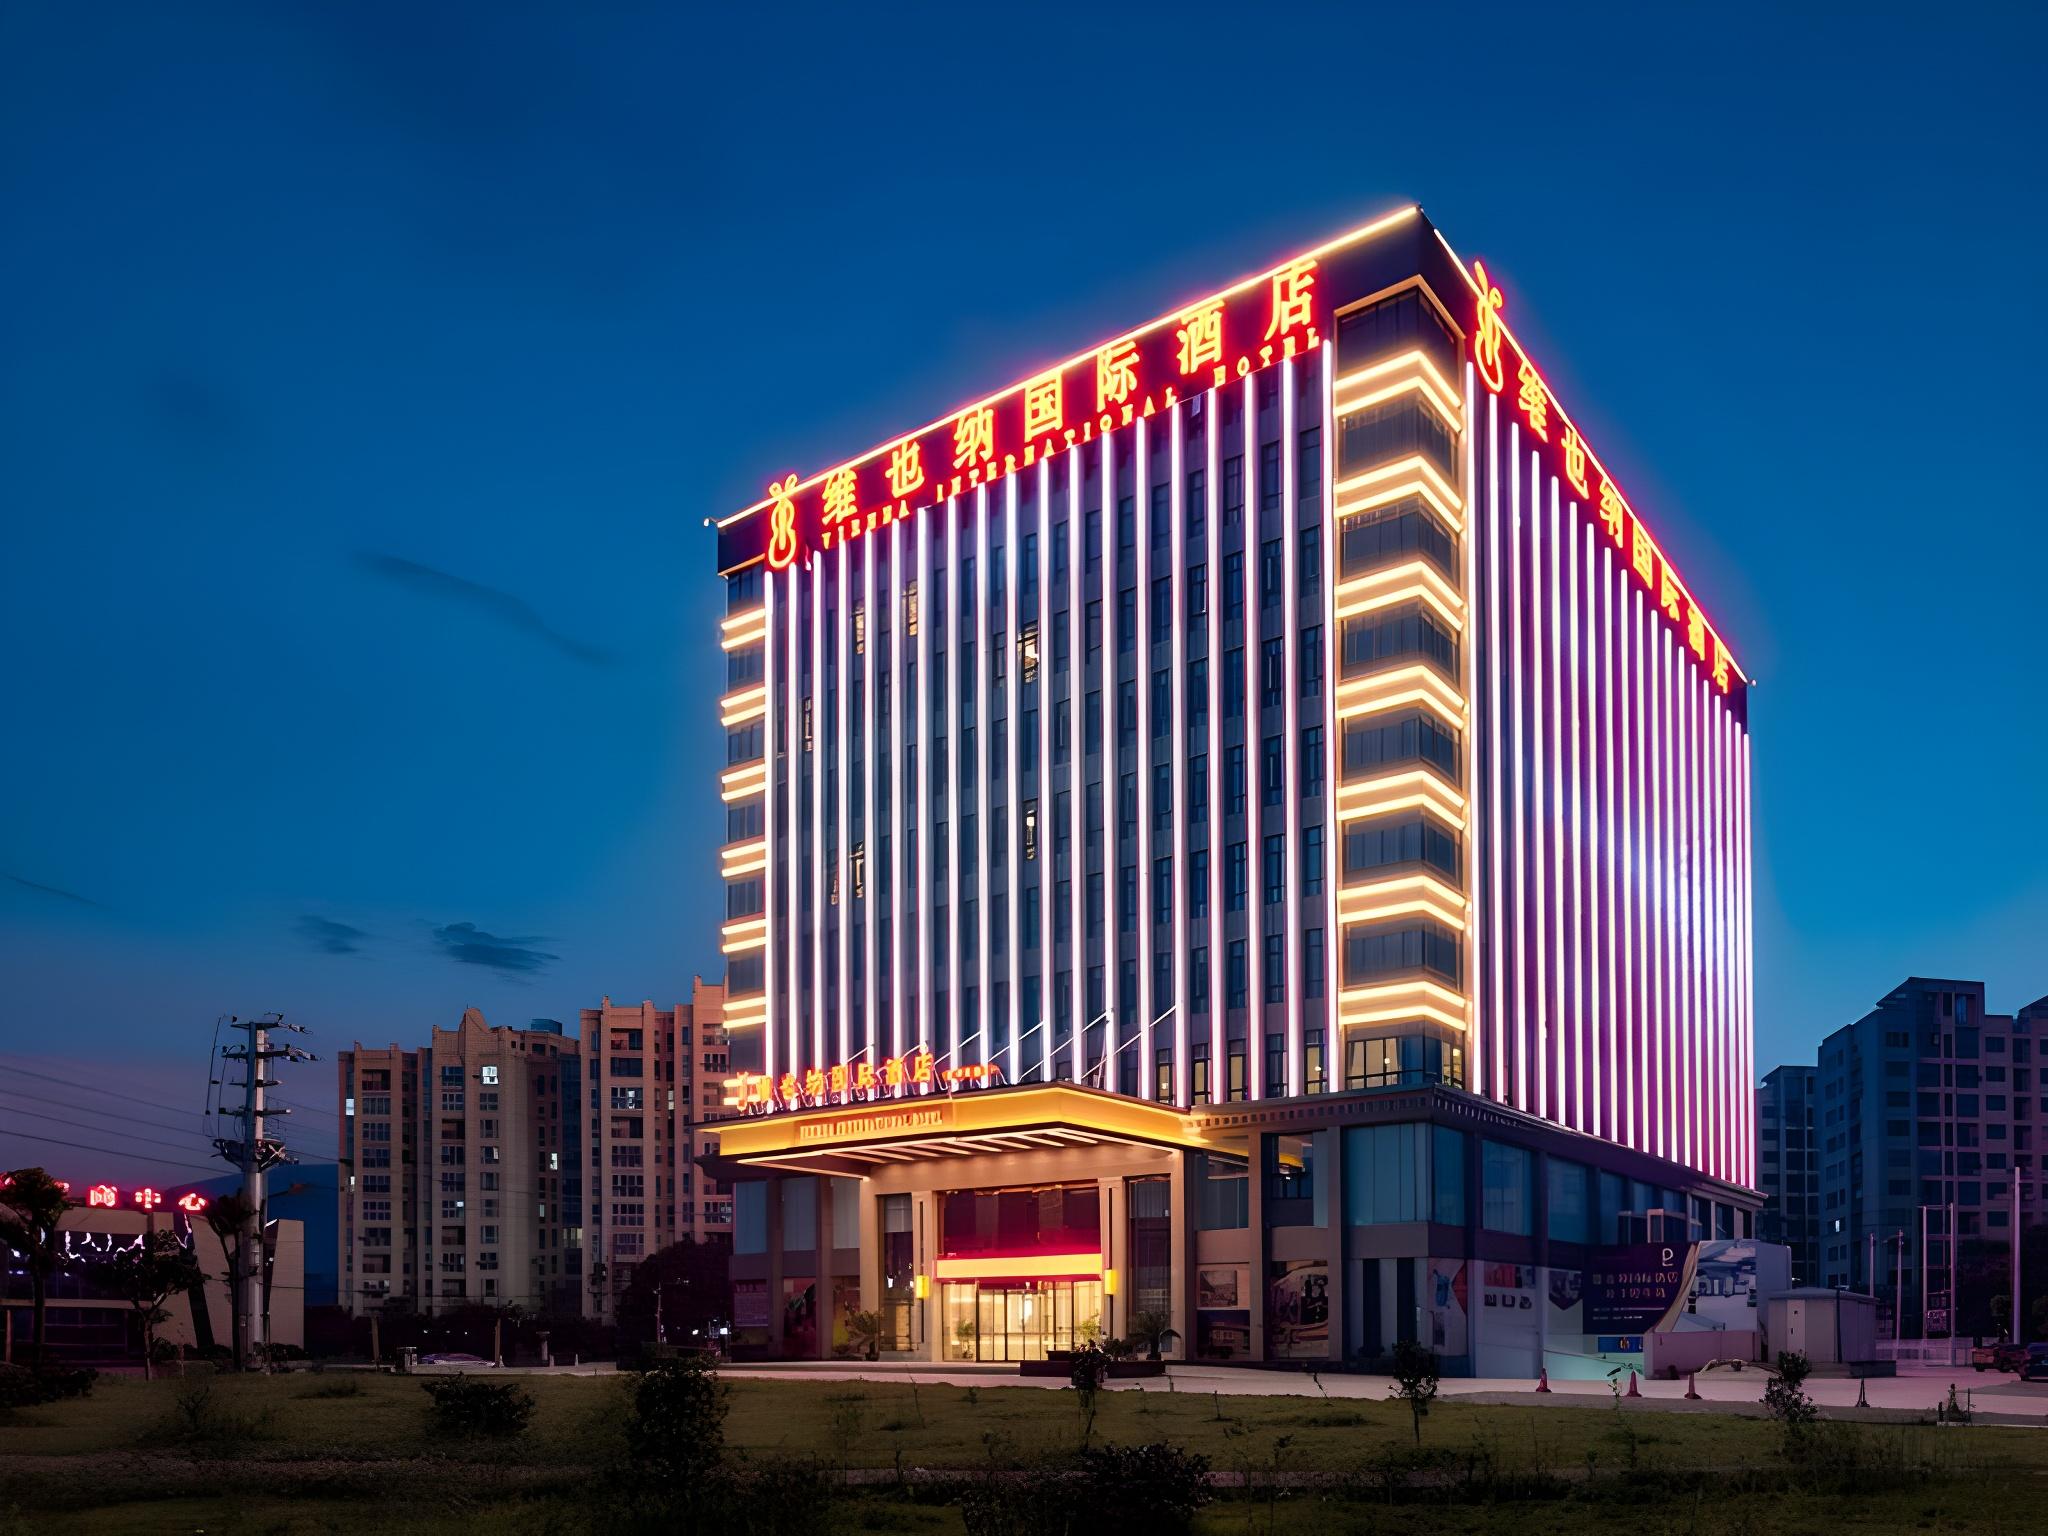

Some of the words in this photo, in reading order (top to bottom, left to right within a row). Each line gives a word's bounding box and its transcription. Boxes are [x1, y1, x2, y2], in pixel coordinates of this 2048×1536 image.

[821, 258, 1318, 526] 维也纳国际酒店
